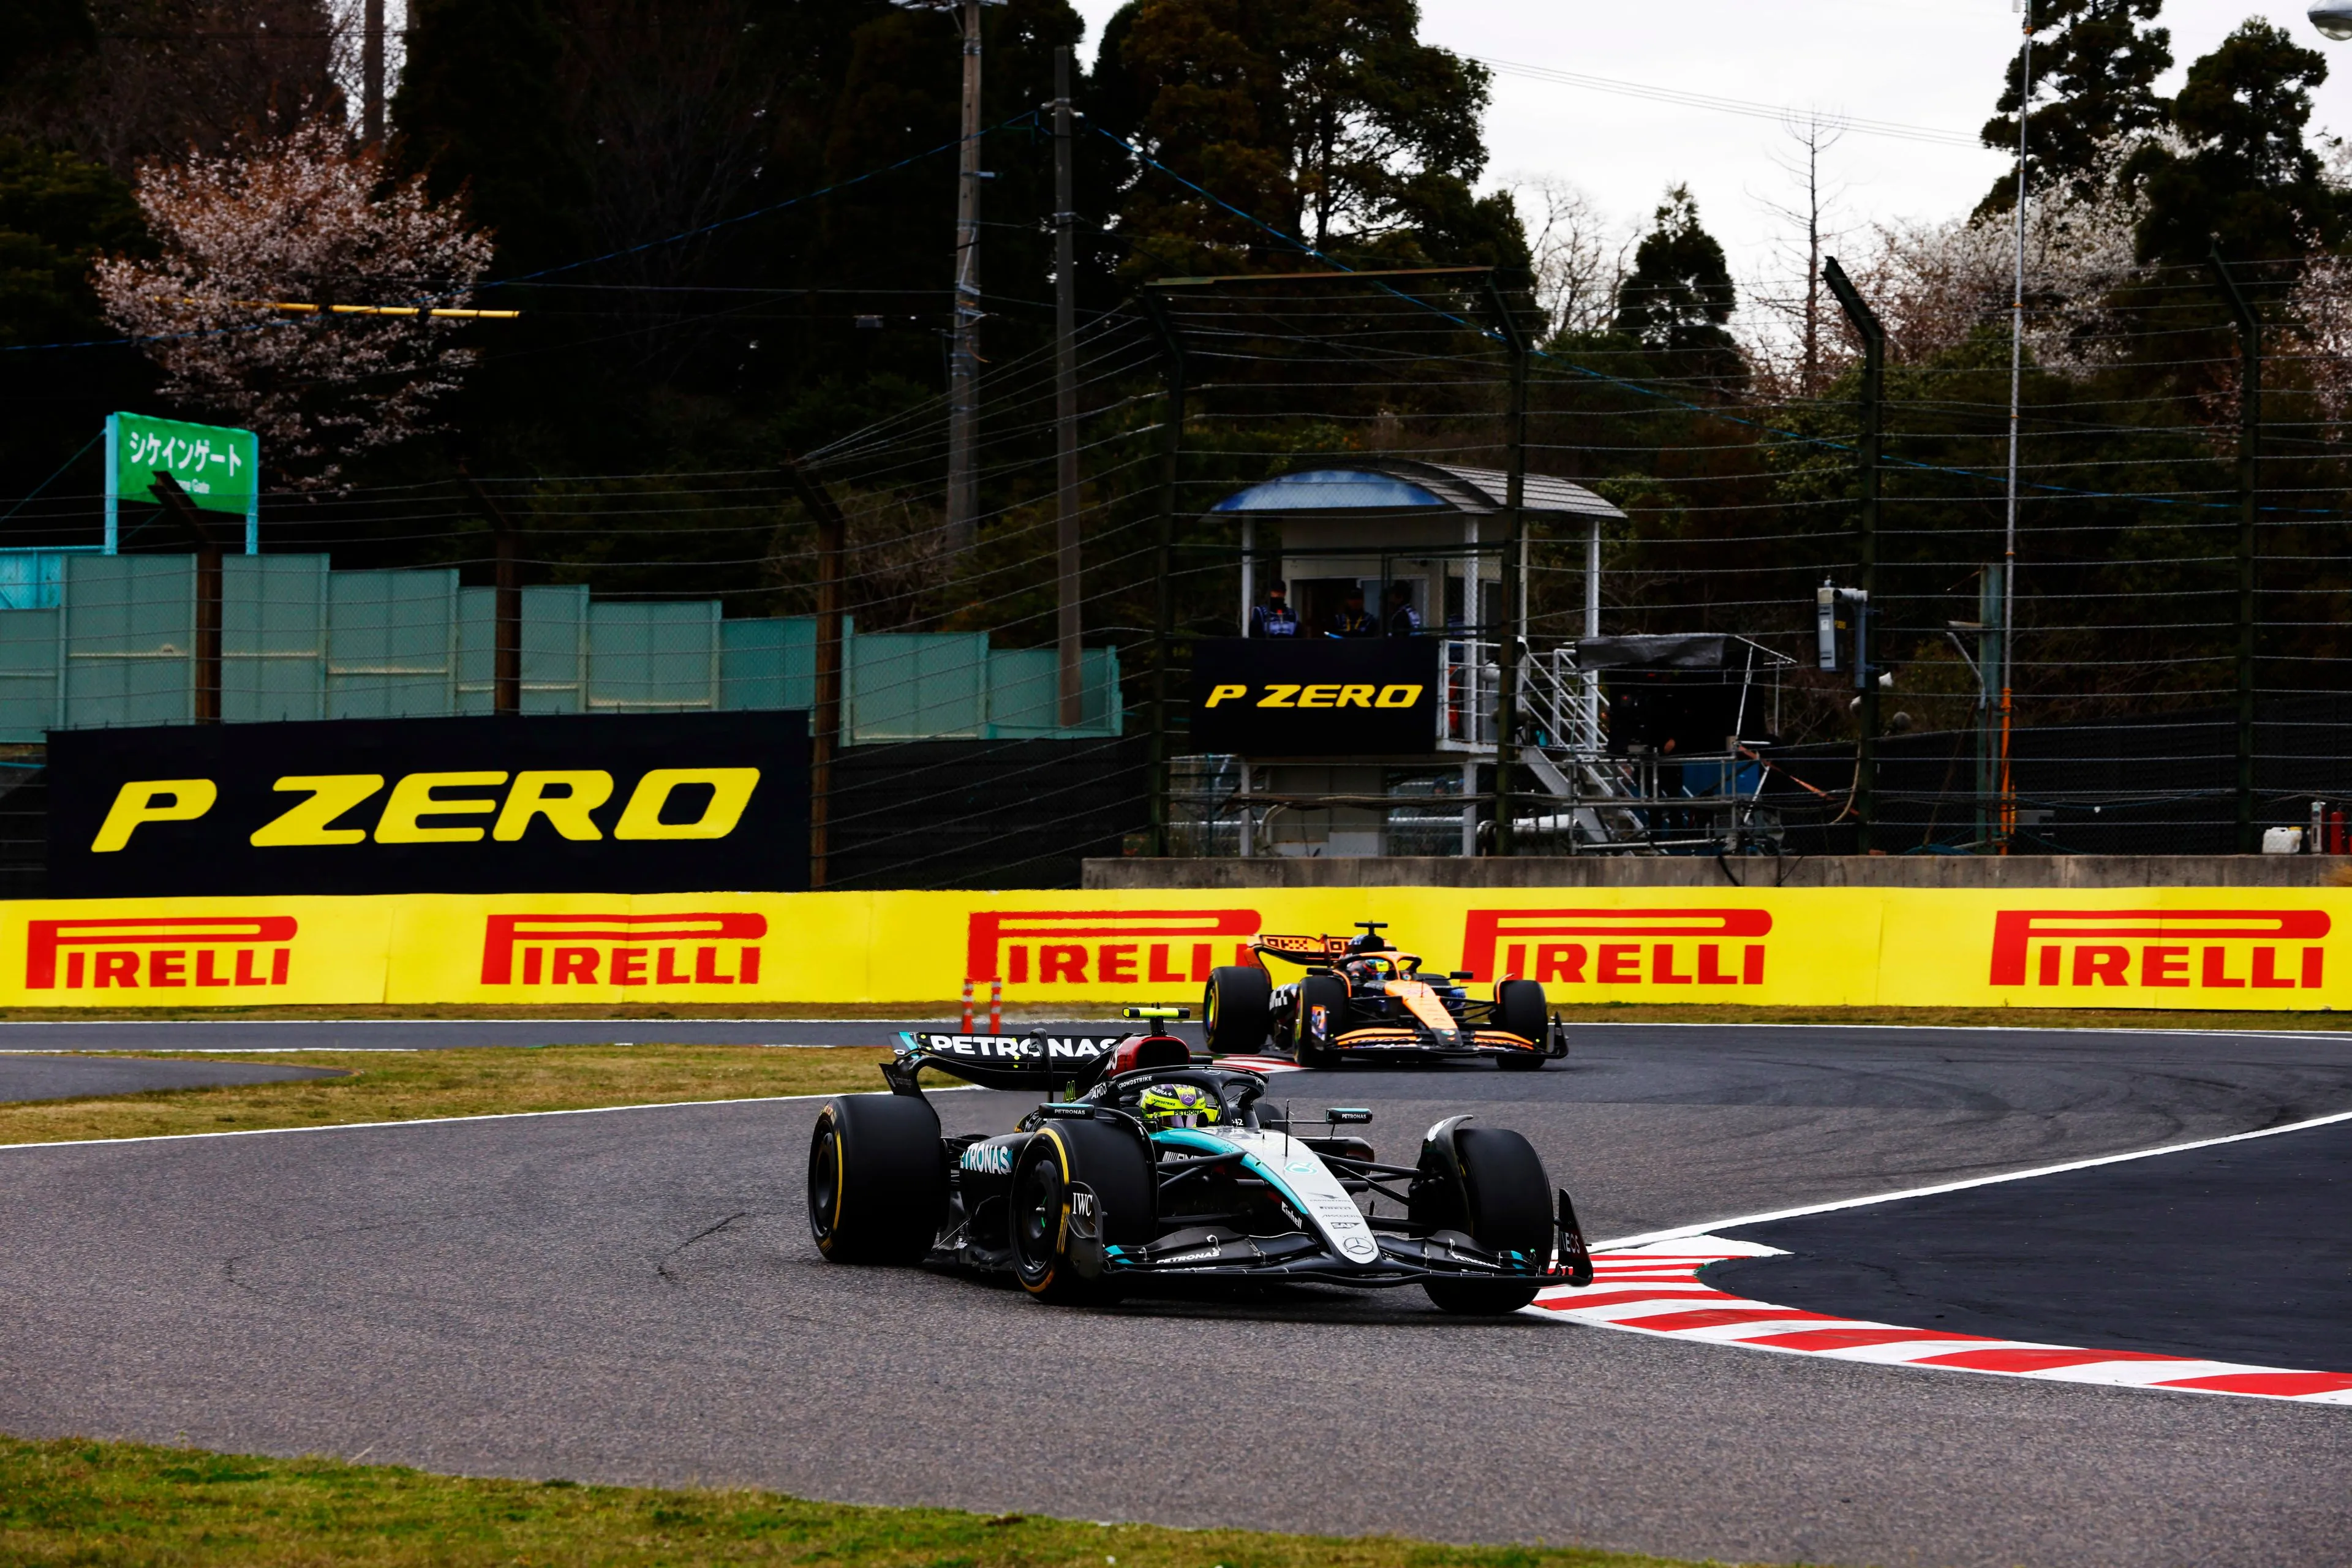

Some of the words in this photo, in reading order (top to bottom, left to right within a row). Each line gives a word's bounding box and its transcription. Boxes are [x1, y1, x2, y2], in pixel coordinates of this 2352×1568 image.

[129, 431, 242, 477] シケインゲート
[1205, 685, 1247, 707] P
[1256, 685, 1423, 707] ZERO
[91, 778, 217, 853] P
[250, 767, 760, 847] ZERO
[26, 916, 298, 989] PIRELLI
[481, 912, 767, 986] PIRELLI
[1460, 908, 1773, 985] PIRELLI
[1989, 910, 2331, 989] PIRELLI
[1118, 1076, 1153, 1089] CROWDSTRIKE
[1072, 1192, 1093, 1217] IWC
[1281, 1200, 1302, 1230] Einhell
[1156, 1250, 1220, 1264] PETRONAS
